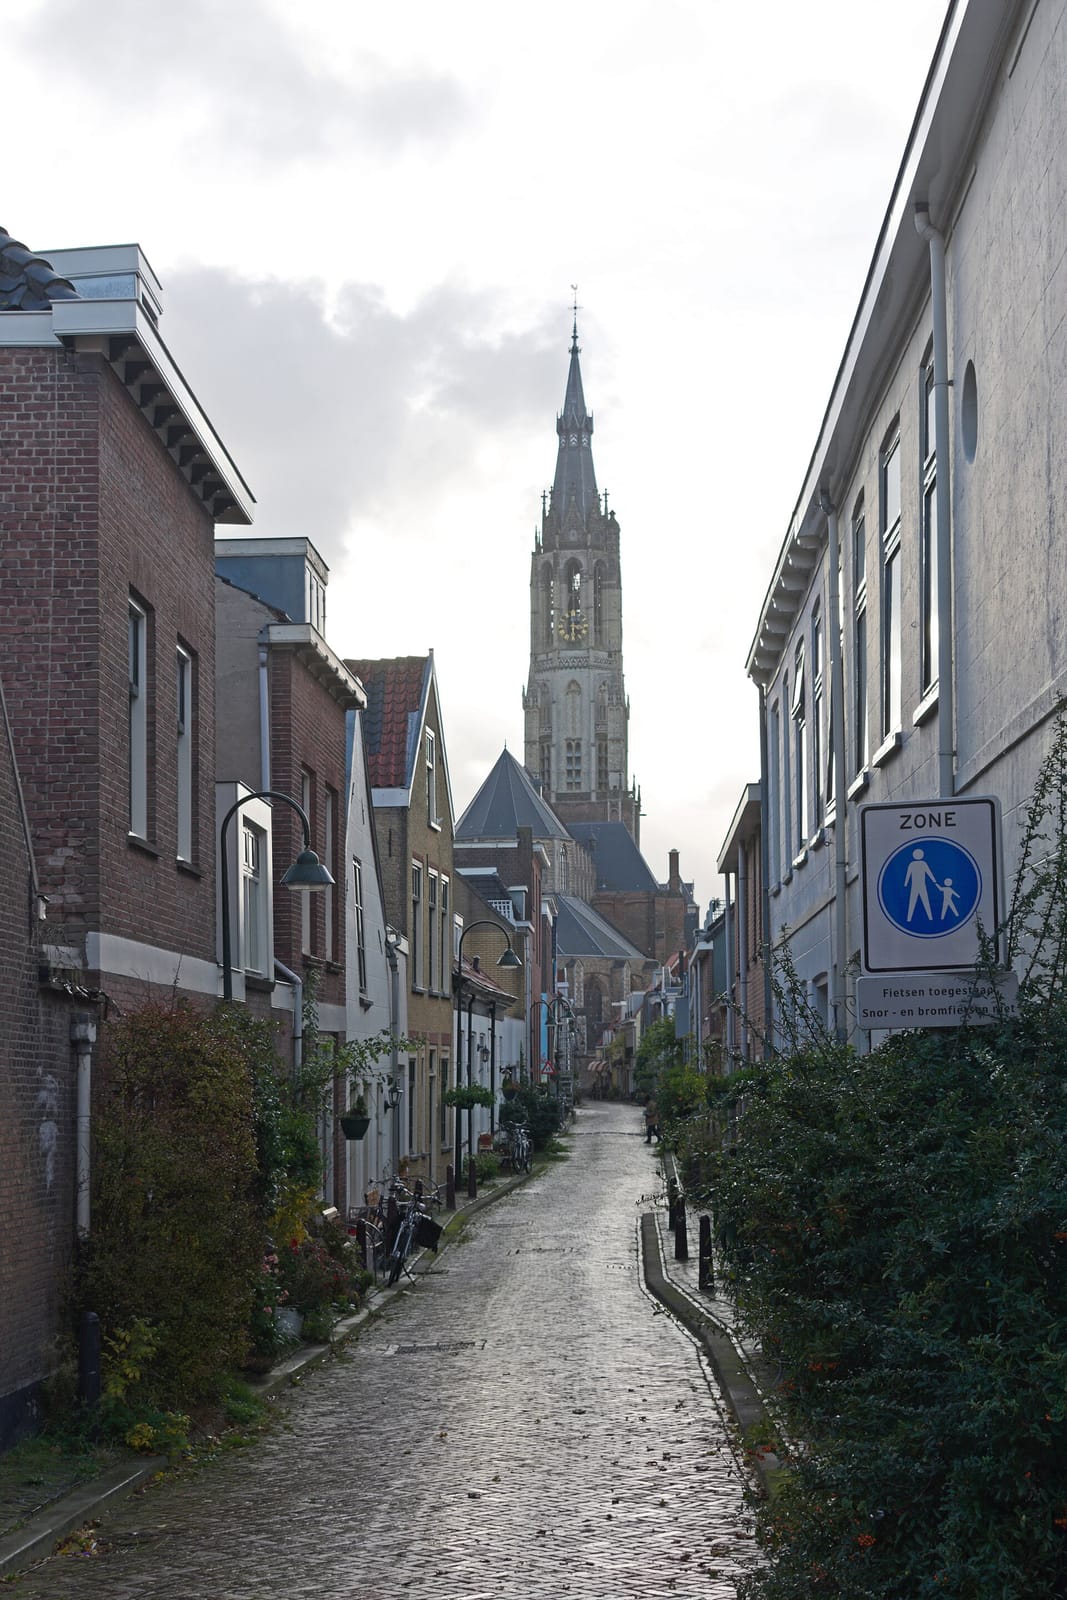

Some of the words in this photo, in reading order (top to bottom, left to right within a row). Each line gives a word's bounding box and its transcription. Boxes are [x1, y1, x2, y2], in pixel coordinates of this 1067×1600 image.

[899, 811, 957, 829] ZONE
[882, 987, 925, 998] Fietsen
[862, 1008, 888, 1018] Snor
[900, 1009, 914, 1017] en
